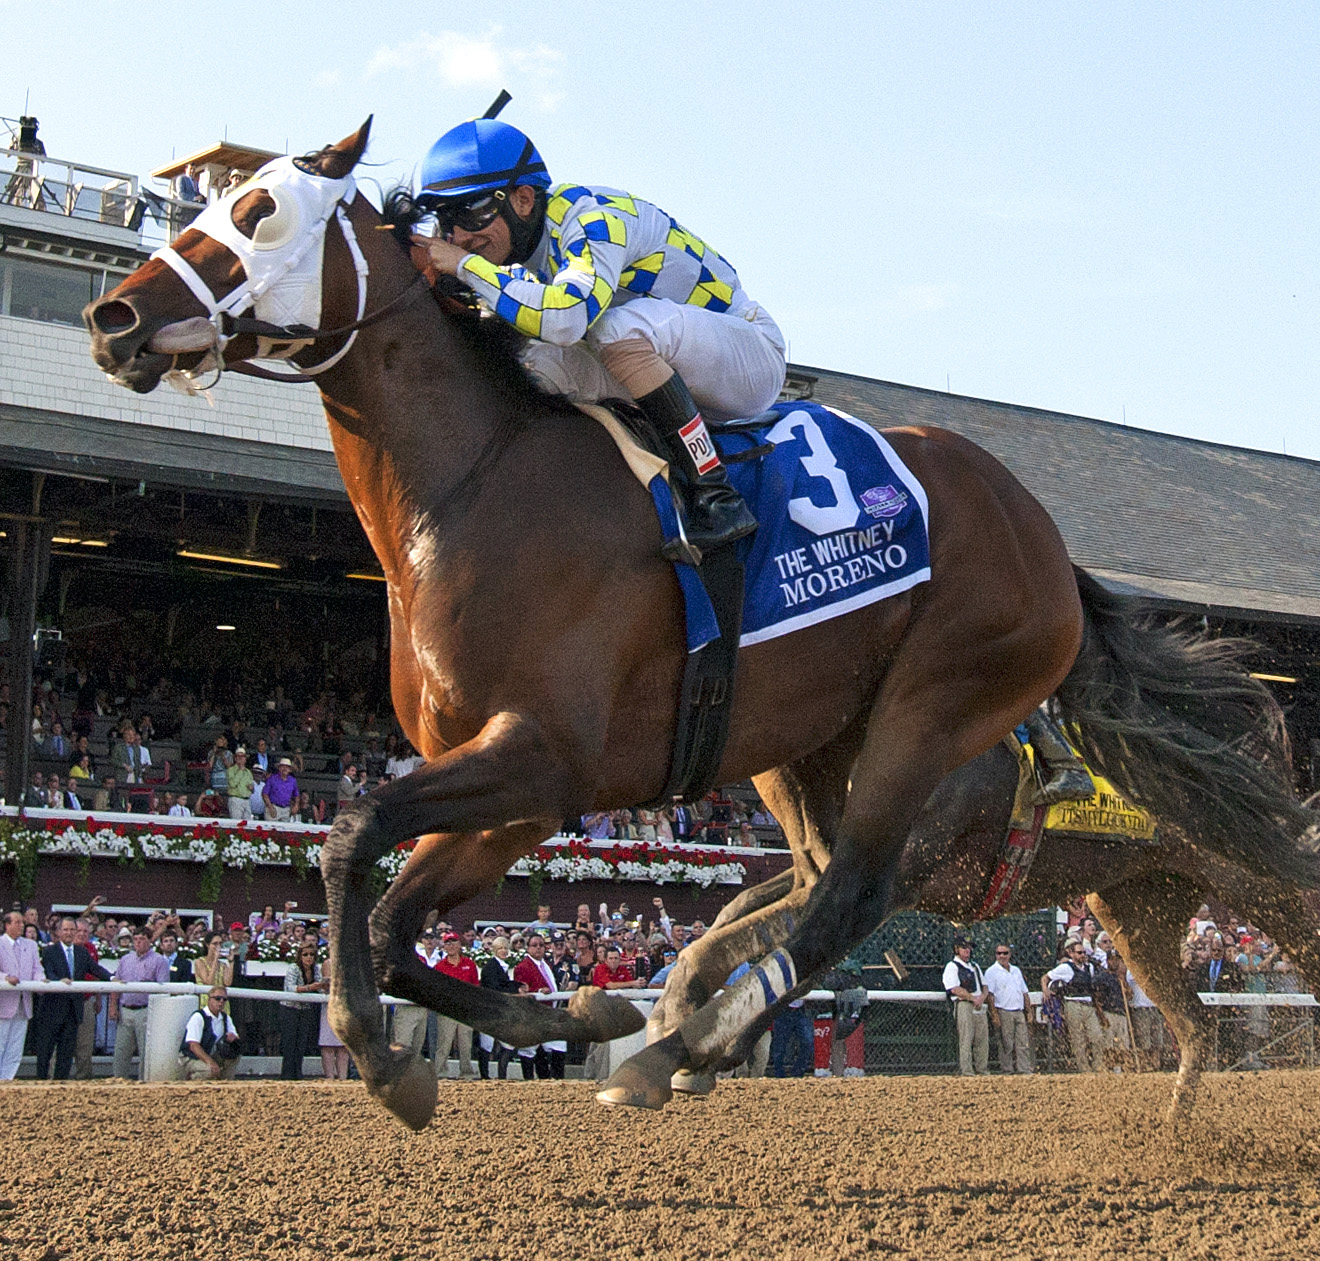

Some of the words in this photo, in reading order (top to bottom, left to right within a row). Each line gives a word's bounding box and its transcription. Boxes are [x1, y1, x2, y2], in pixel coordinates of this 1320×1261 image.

[765, 410, 860, 535] 3
[775, 548, 812, 579] THE
[811, 520, 894, 565] WHITNEY
[780, 544, 907, 607] MORENO
